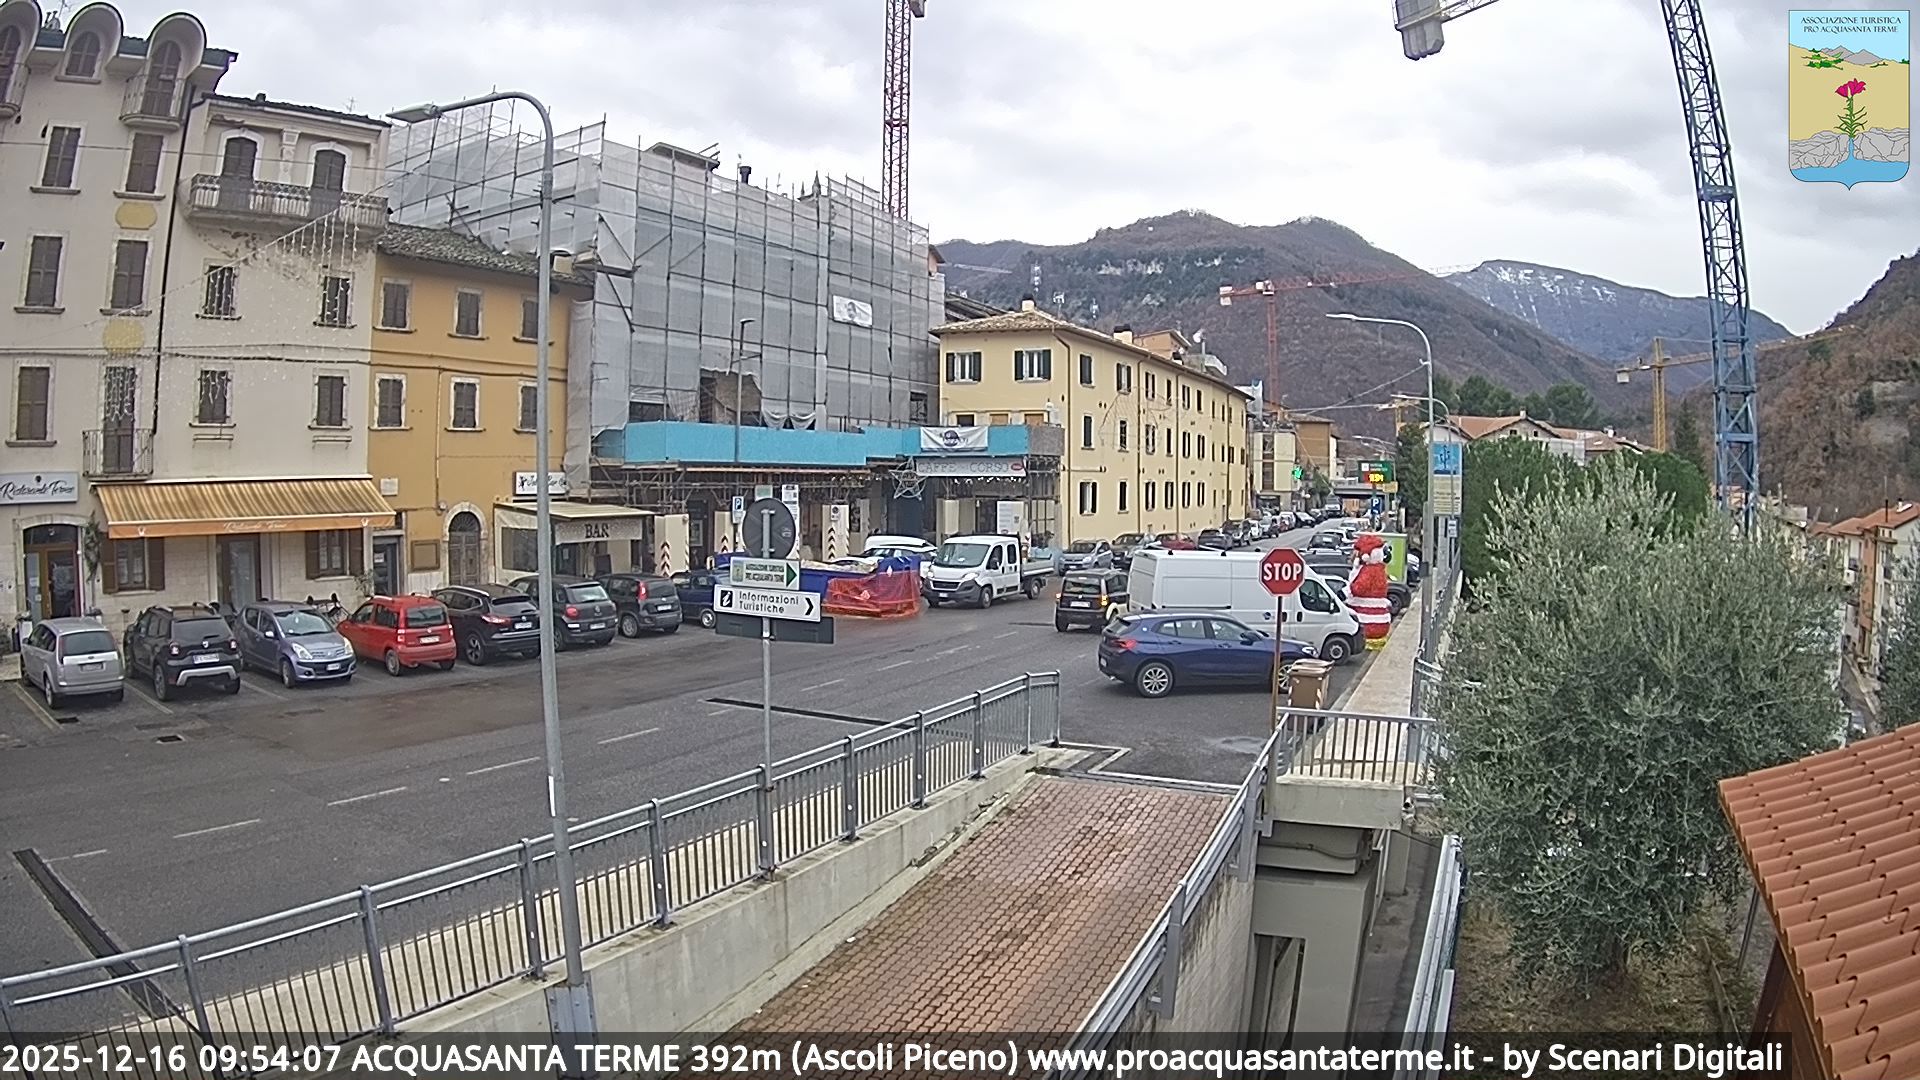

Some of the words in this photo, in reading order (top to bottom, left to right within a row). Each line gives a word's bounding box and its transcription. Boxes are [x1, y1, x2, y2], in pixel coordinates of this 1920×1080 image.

[1372, 498, 1379, 507] P
[584, 523, 610, 538] BAR
[1263, 562, 1302, 581] STOP
[739, 591, 799, 605] Informazioni
[739, 601, 785, 614] Turistiche
